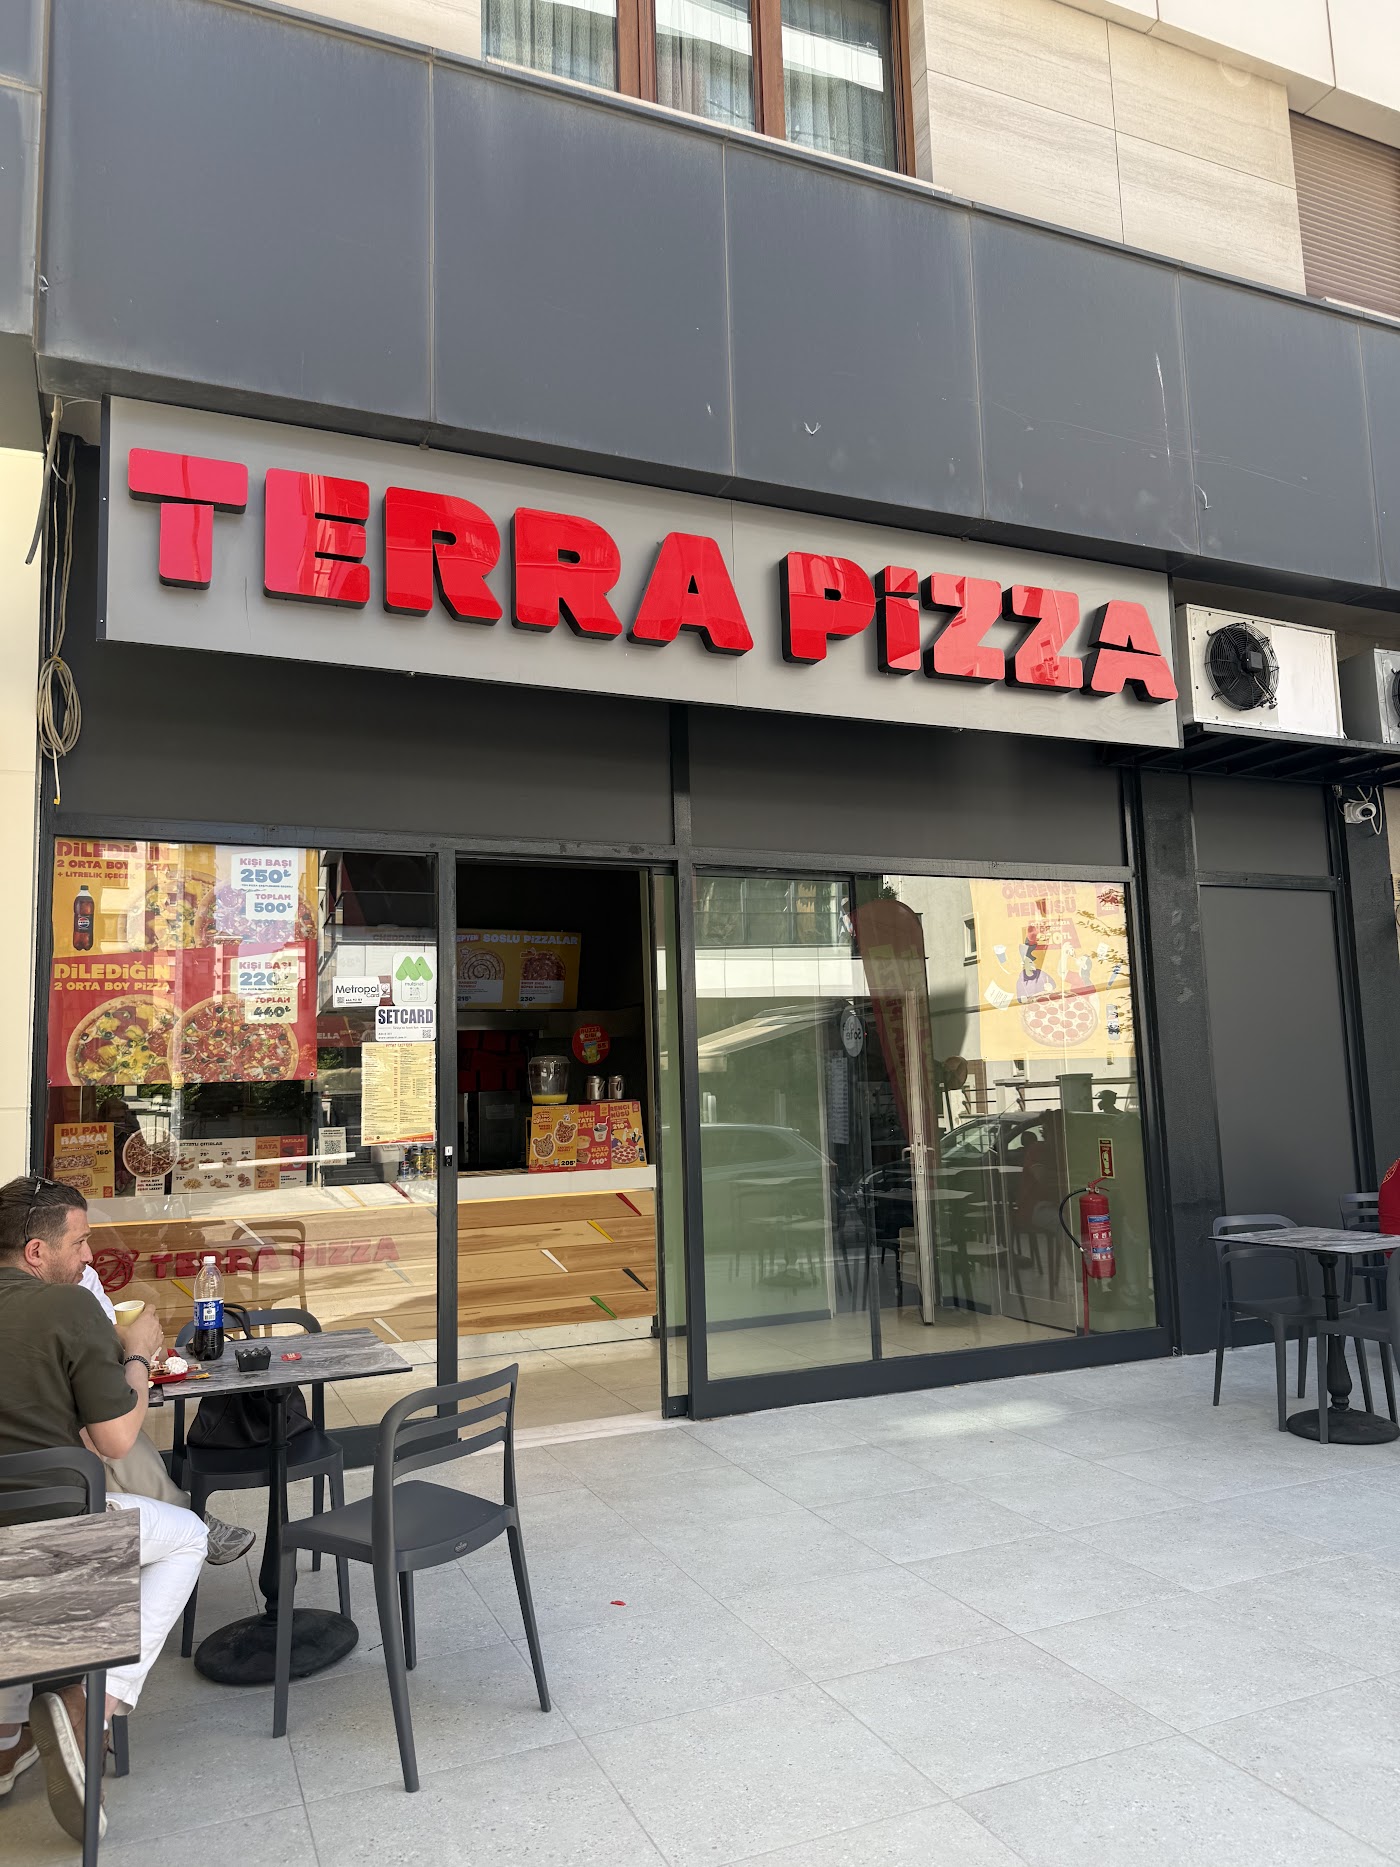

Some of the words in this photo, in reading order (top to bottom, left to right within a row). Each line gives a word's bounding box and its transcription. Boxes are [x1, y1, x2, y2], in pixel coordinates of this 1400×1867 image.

[128, 448, 754, 656] TERRA
[57, 860, 65, 869] 2
[68, 861, 102, 869] ORTA
[106, 861, 129, 870] BOY
[255, 893, 291, 901] TOPLAM
[482, 933, 520, 944] SOSLU
[53, 981, 63, 991] 2
[66, 981, 101, 991] ORTA
[104, 982, 130, 991] BOY
[335, 984, 380, 998] Metropol
[255, 996, 291, 1004] TOPLAM
[378, 1008, 434, 1025] SETCARD
[61, 1128, 79, 1137] BU
[82, 1125, 107, 1135] PAN
[61, 1133, 108, 1146] BAŞKA!
[151, 1246, 281, 1279] TERRA
[292, 1237, 400, 1268] PIZZA
